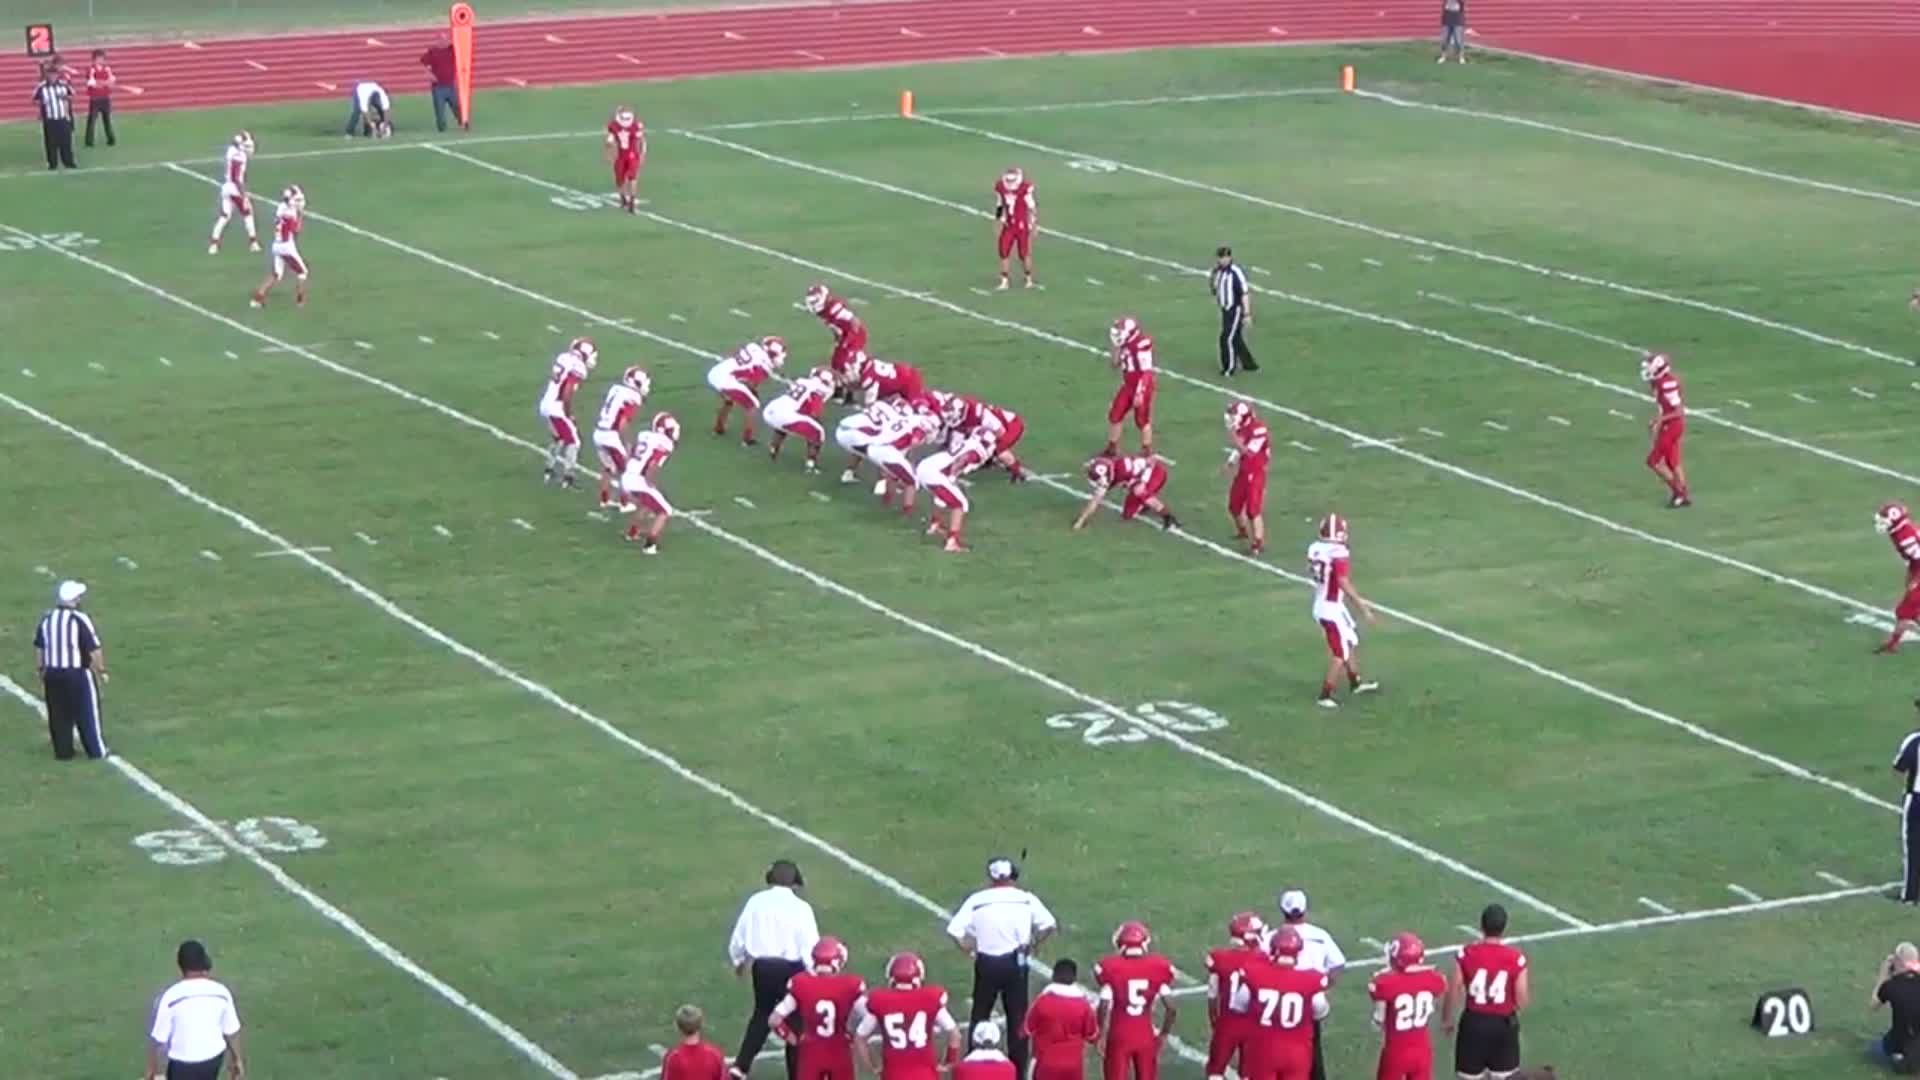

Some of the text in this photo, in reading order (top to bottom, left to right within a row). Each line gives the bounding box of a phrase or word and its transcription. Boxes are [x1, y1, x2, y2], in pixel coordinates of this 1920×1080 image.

[31, 27, 50, 53] 2
[1046, 700, 1230, 745] 20
[1127, 979, 1149, 1016] 5
[1469, 968, 1508, 1005] 44
[816, 1000, 836, 1037] 3
[1258, 988, 1304, 1029] 70
[1395, 991, 1434, 1031] 20
[1763, 994, 1811, 1037] 20
[884, 1011, 928, 1049] 54
